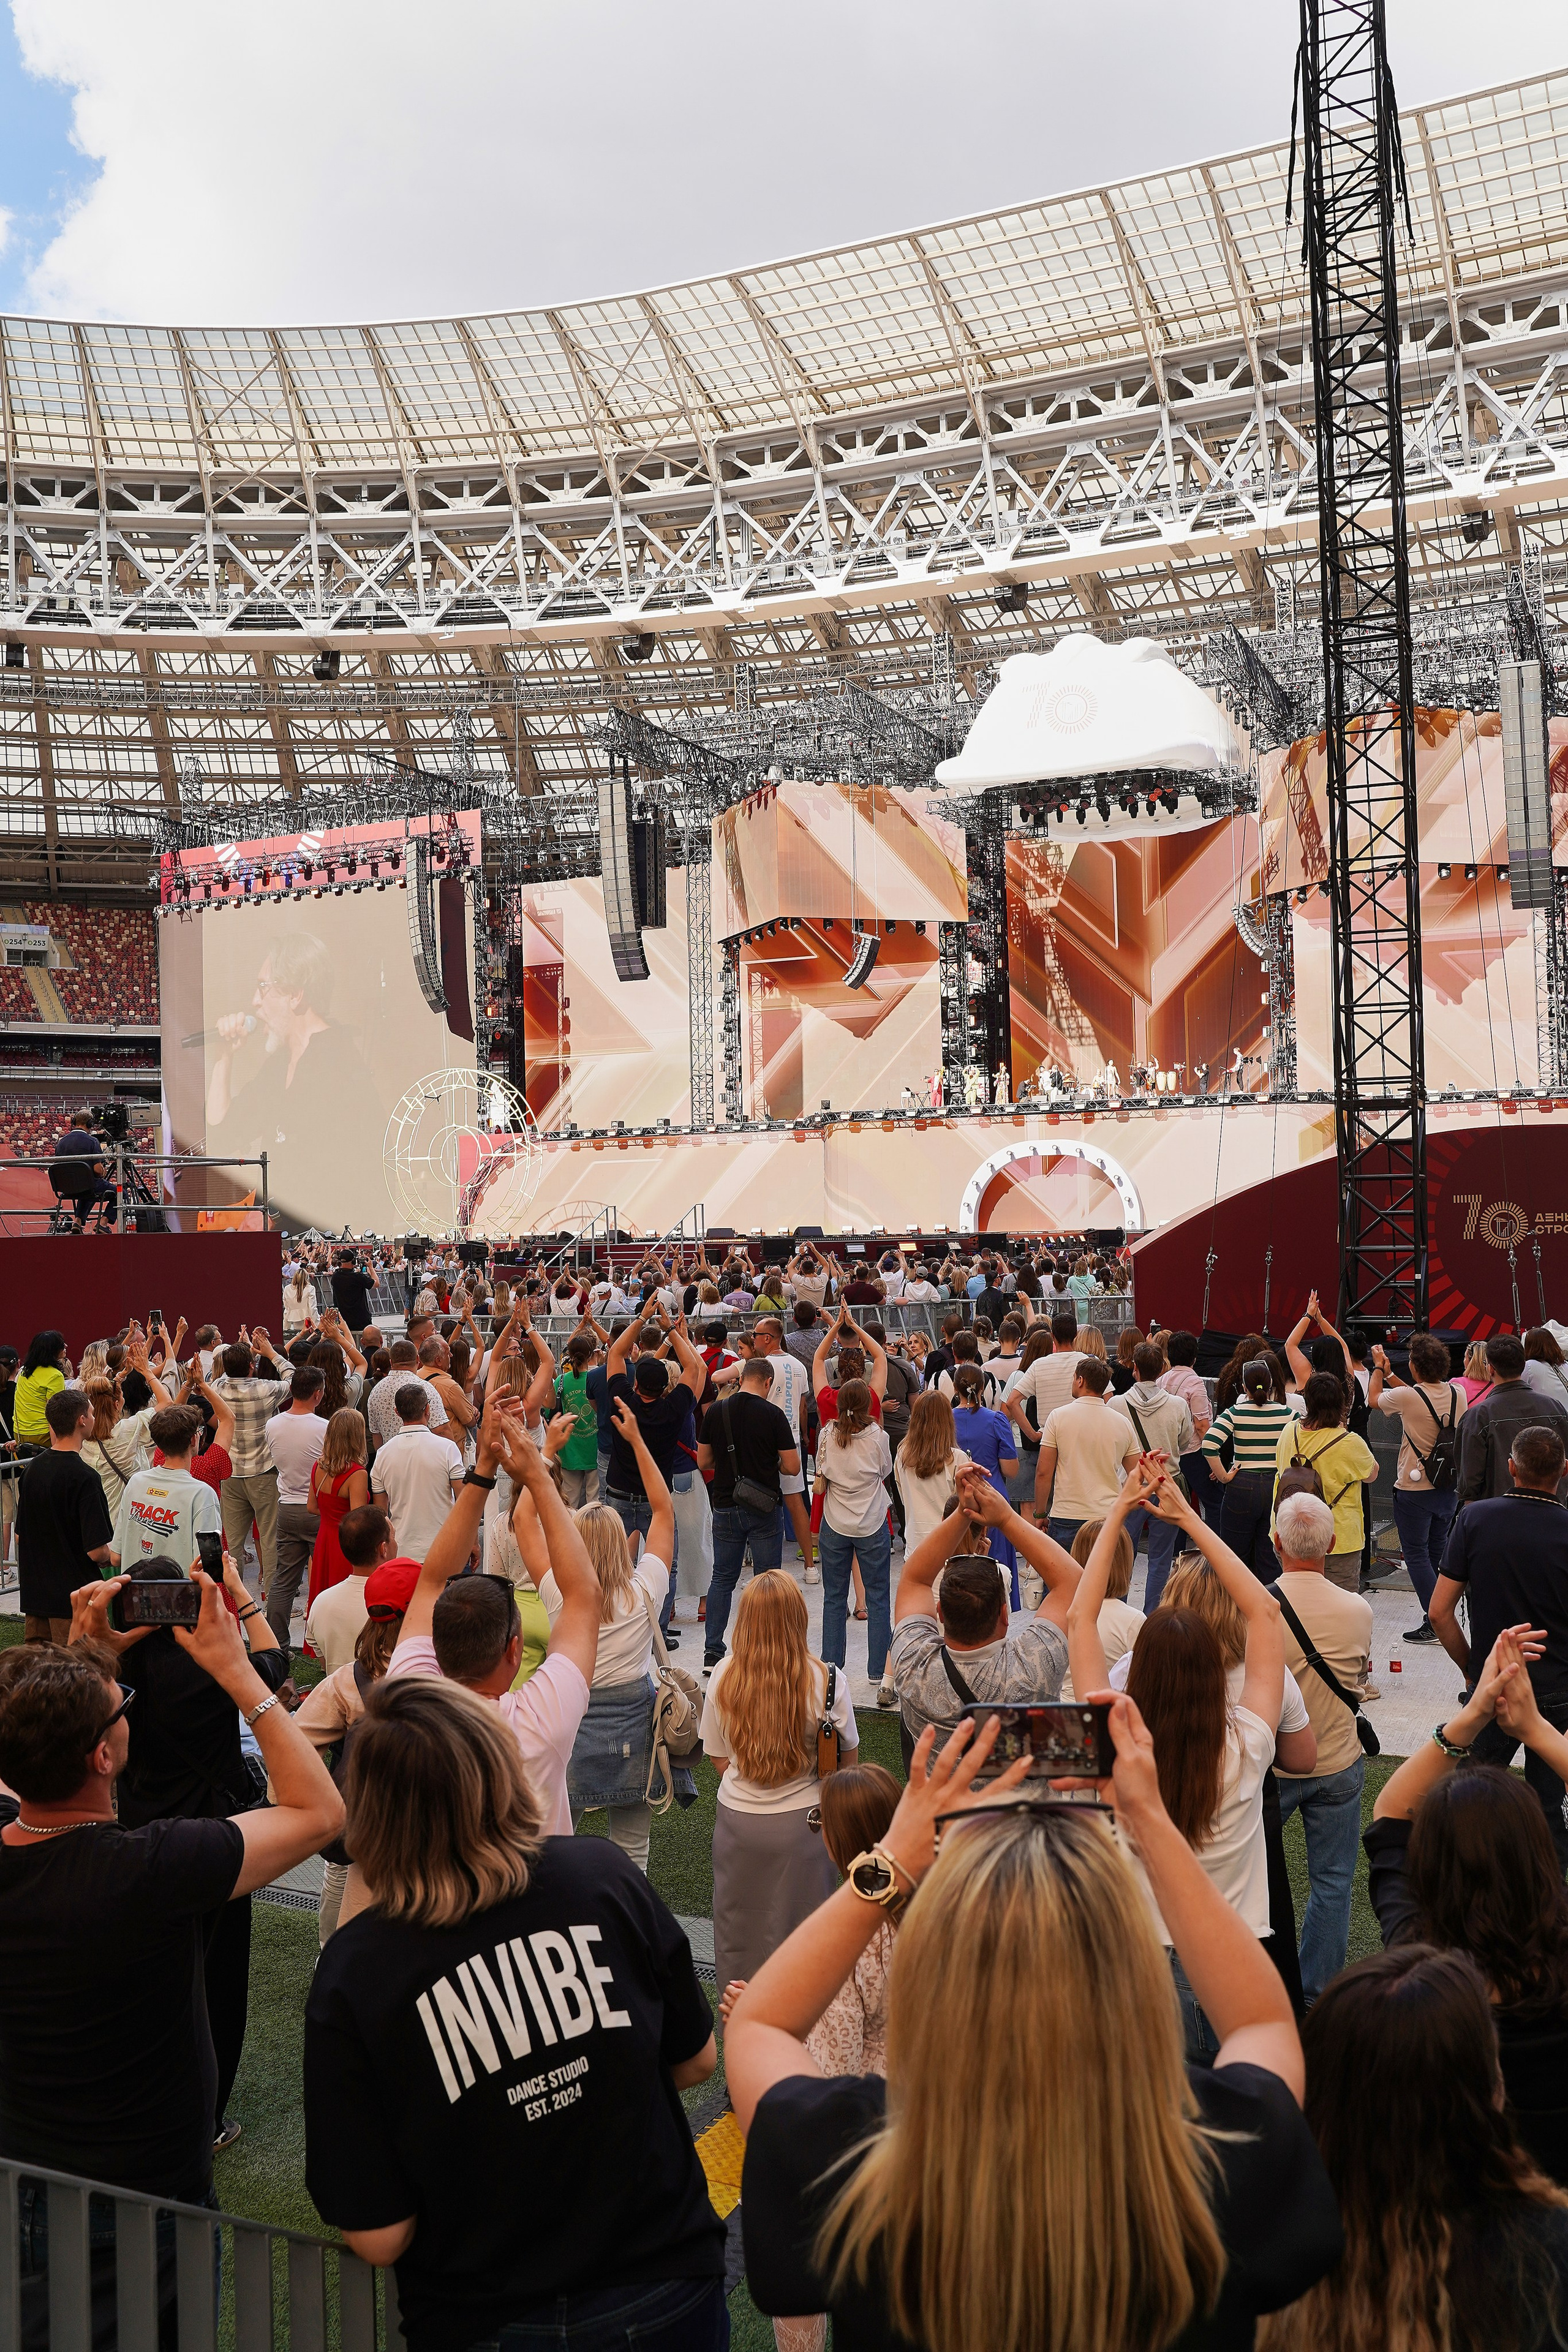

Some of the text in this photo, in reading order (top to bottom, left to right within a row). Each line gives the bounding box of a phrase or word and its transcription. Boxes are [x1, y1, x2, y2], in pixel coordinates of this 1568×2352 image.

[1453, 1194, 1529, 1249] 70
[783, 1363, 794, 1425] QUAPOLIS
[130, 1501, 180, 1525] TRACK
[415, 1924, 632, 2105] INVIBE
[507, 2056, 589, 2106] DANCE STUDIO
[524, 2082, 582, 2122] EST. 2024
